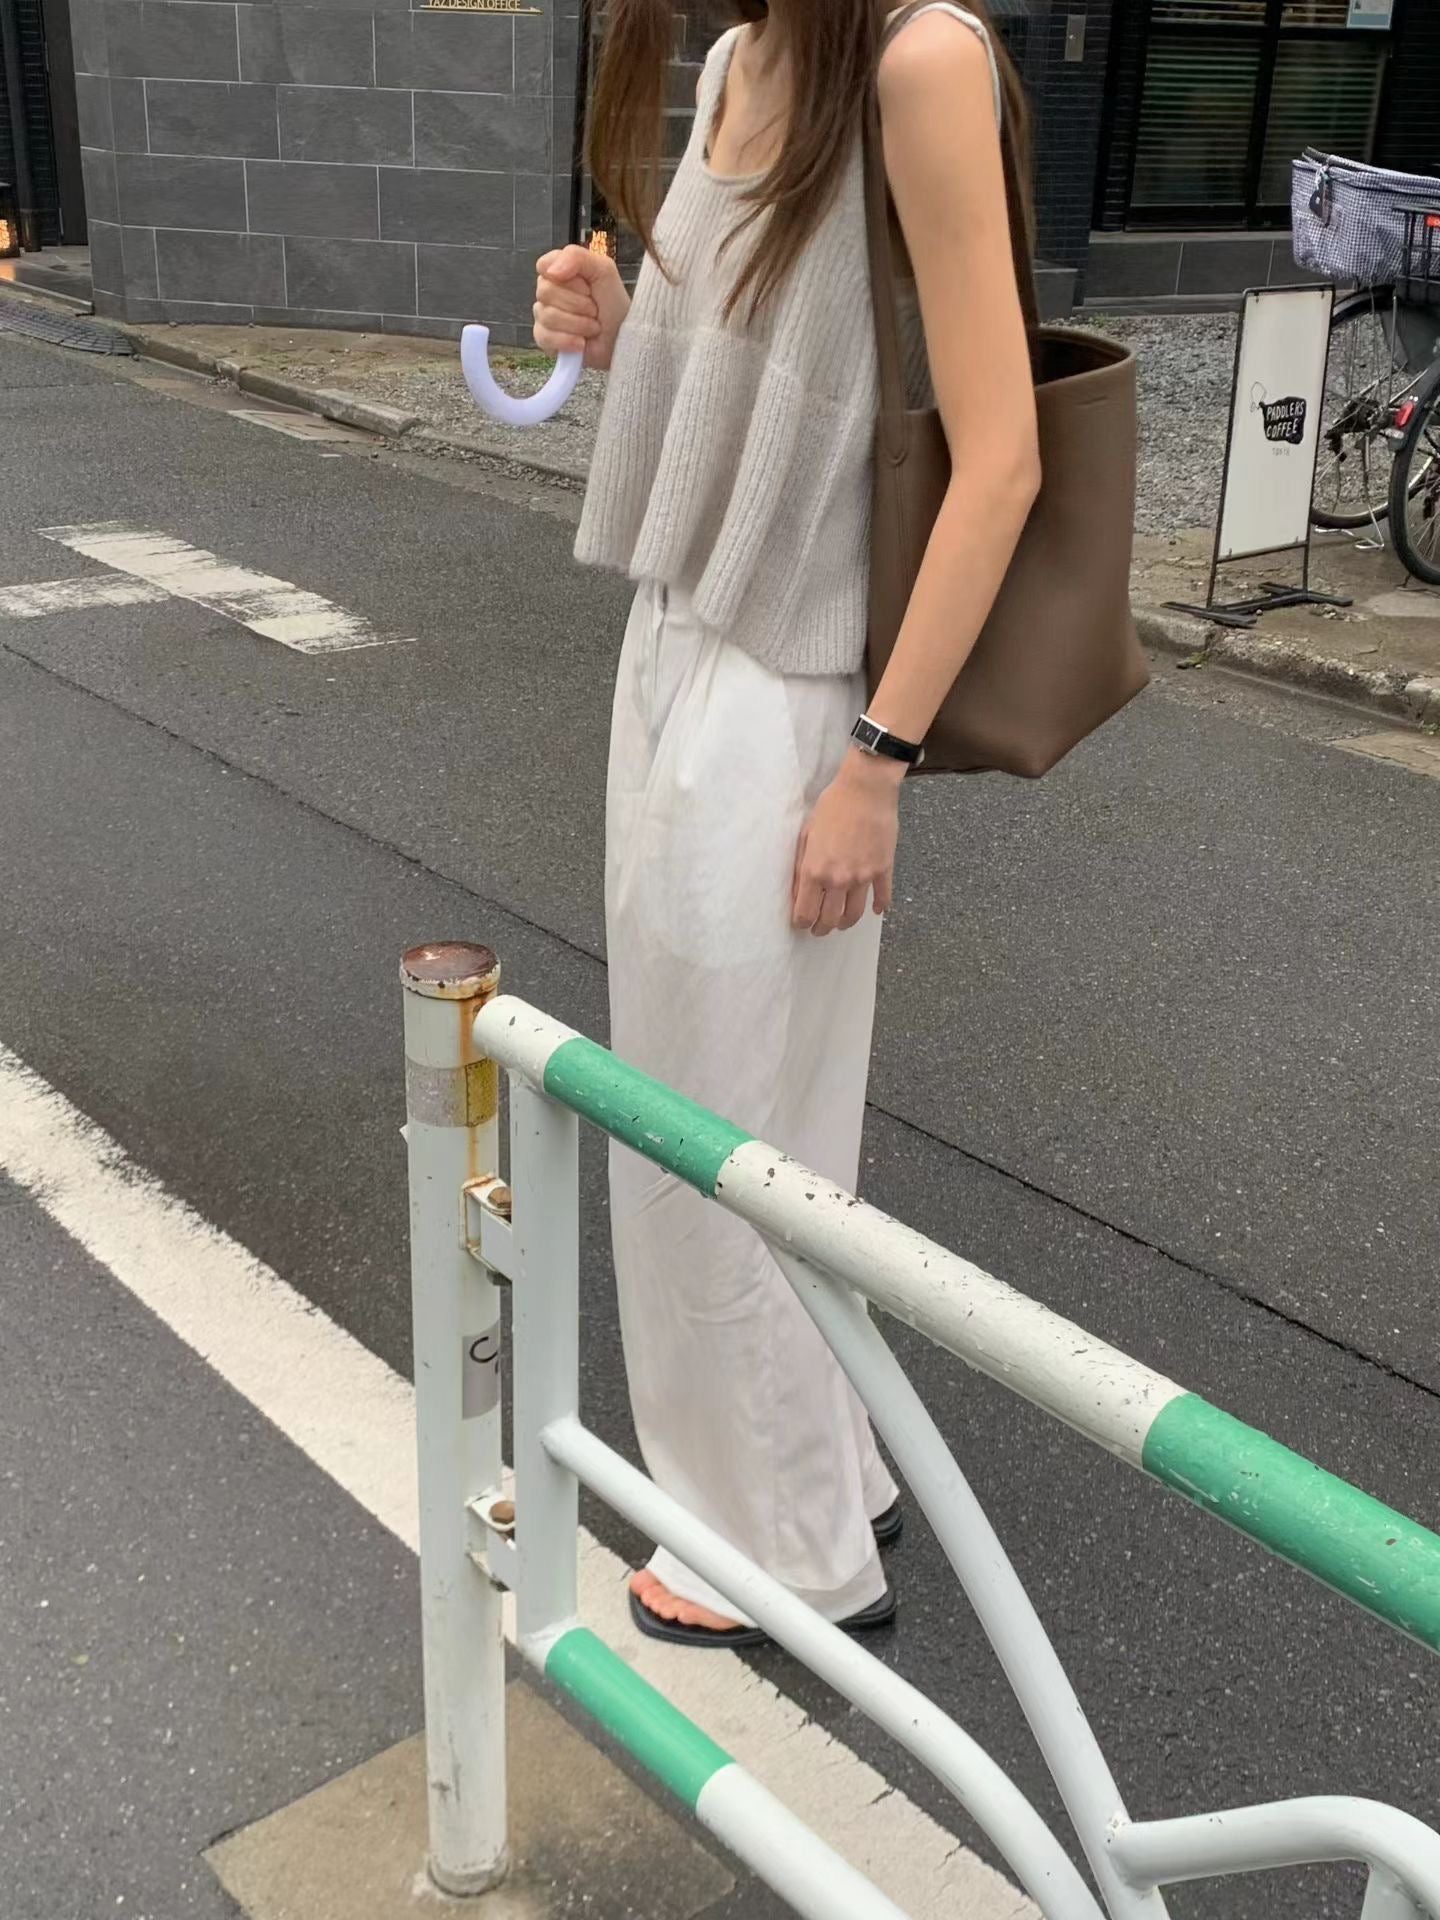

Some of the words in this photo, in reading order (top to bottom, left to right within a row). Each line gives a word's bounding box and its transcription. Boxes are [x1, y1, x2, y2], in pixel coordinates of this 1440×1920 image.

[449, 0, 485, 8] DESIGN
[486, 0, 521, 10] OFFICE
[1266, 401, 1305, 421] PADDLERS
[1266, 418, 1299, 438] COFFEE
